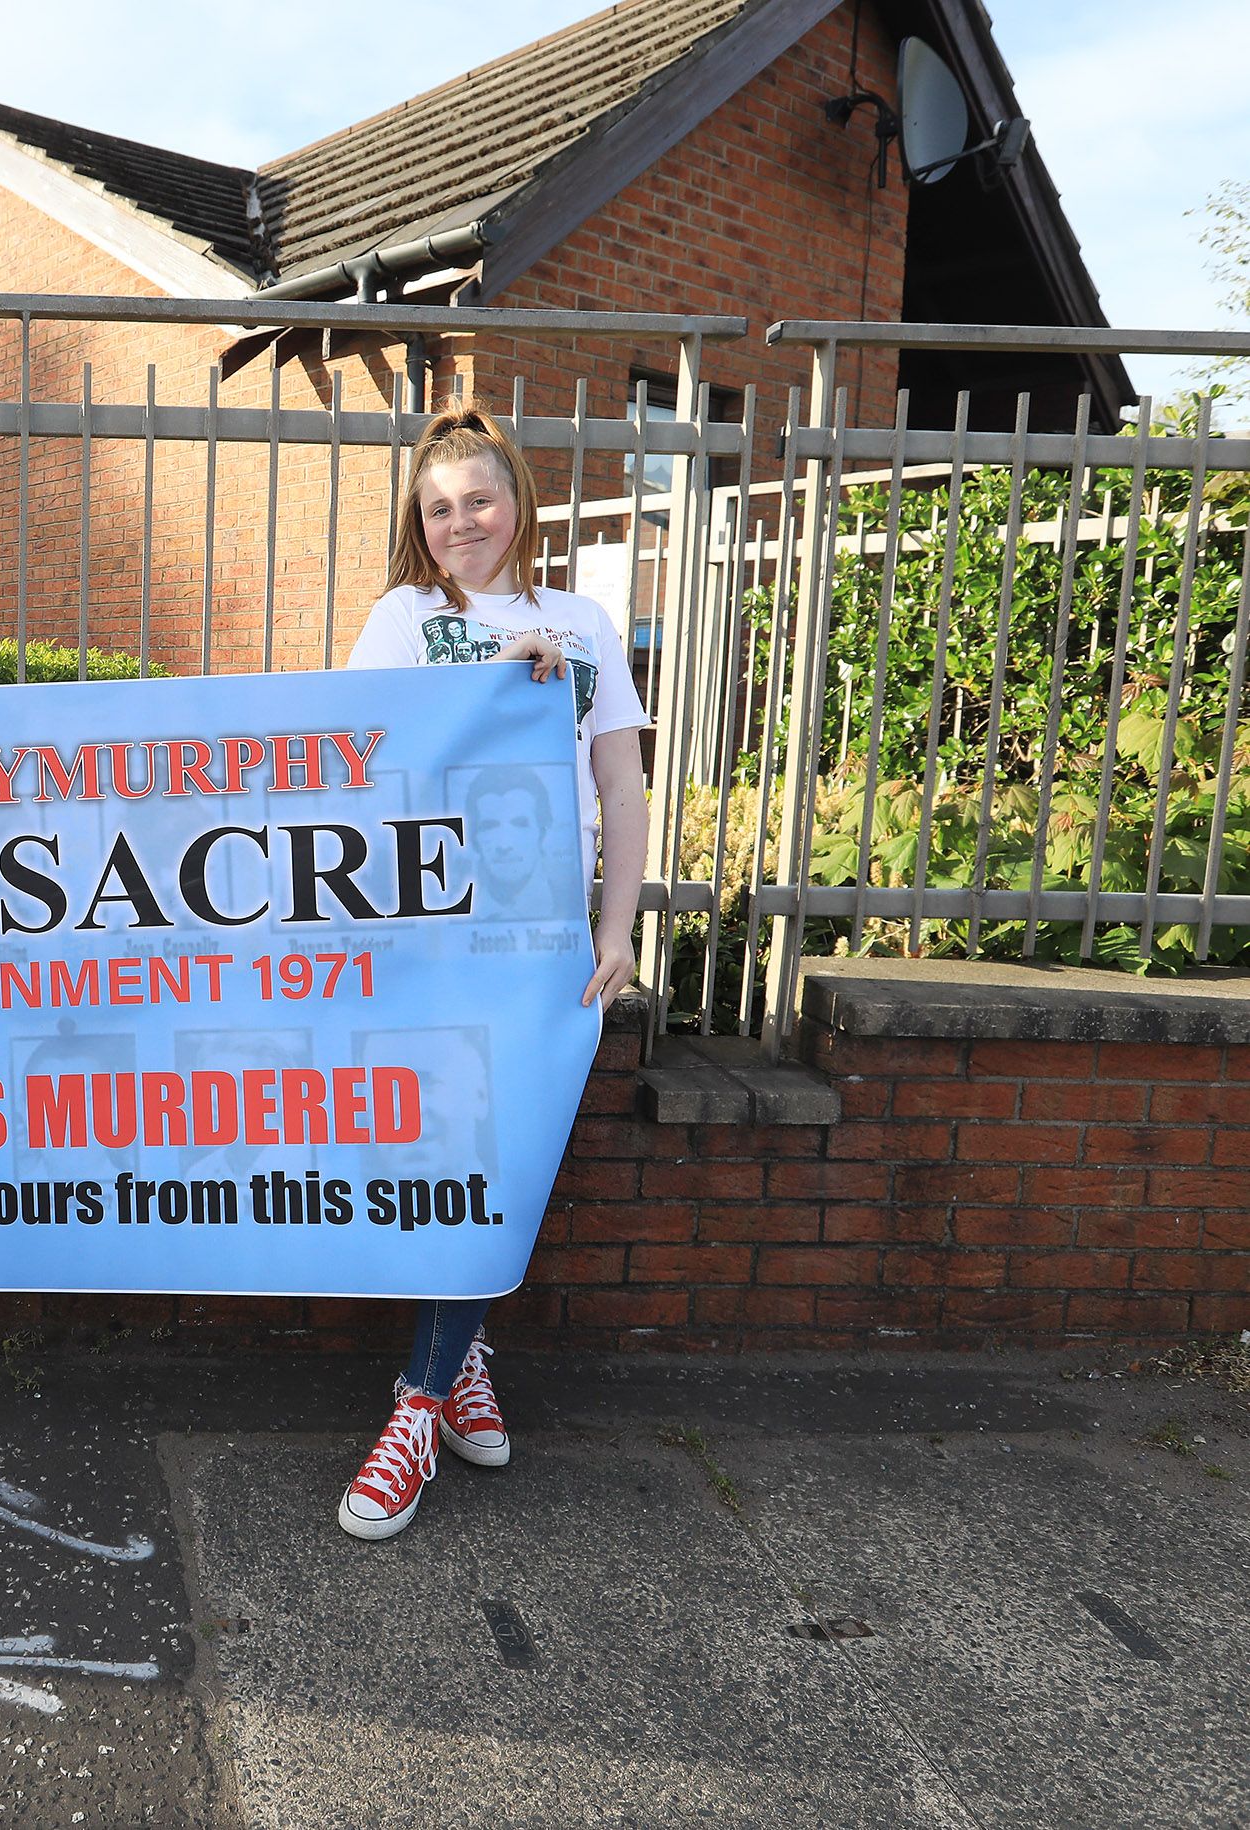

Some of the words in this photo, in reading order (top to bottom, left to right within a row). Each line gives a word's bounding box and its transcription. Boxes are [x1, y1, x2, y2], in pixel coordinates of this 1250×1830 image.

[251, 950, 374, 1001] 1971
[26, 1066, 422, 1149] MURDERED
[113, 1172, 239, 1225] from
[249, 1170, 355, 1226] this
[365, 1172, 504, 1232] spot.
